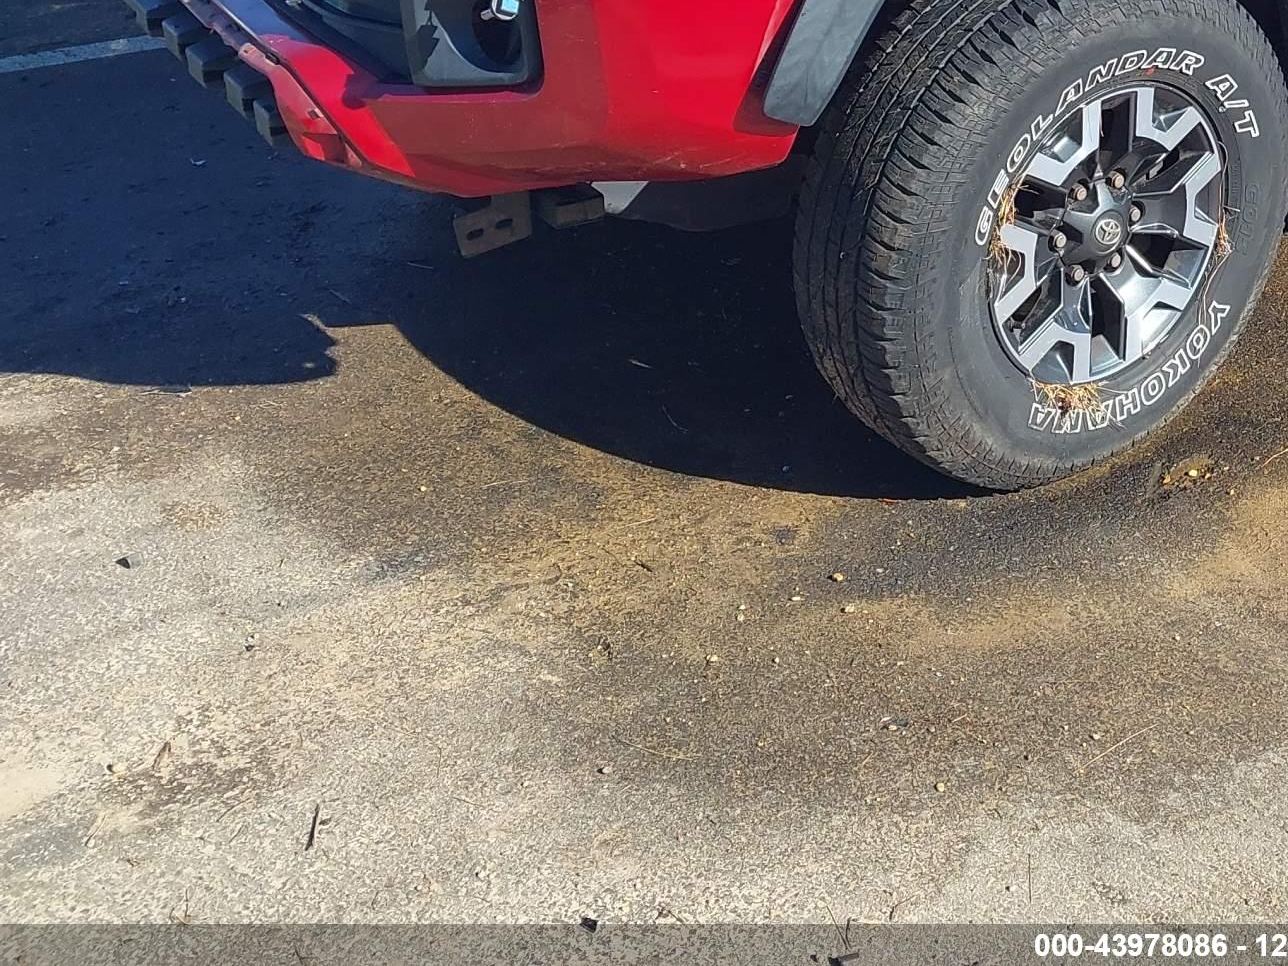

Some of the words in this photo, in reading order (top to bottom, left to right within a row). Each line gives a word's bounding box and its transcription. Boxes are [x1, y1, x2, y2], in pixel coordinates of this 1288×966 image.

[975, 47, 1205, 245] GEOLANDAR
[1205, 74, 1260, 138] A/T
[1028, 300, 1231, 434] YOKOHAMA
